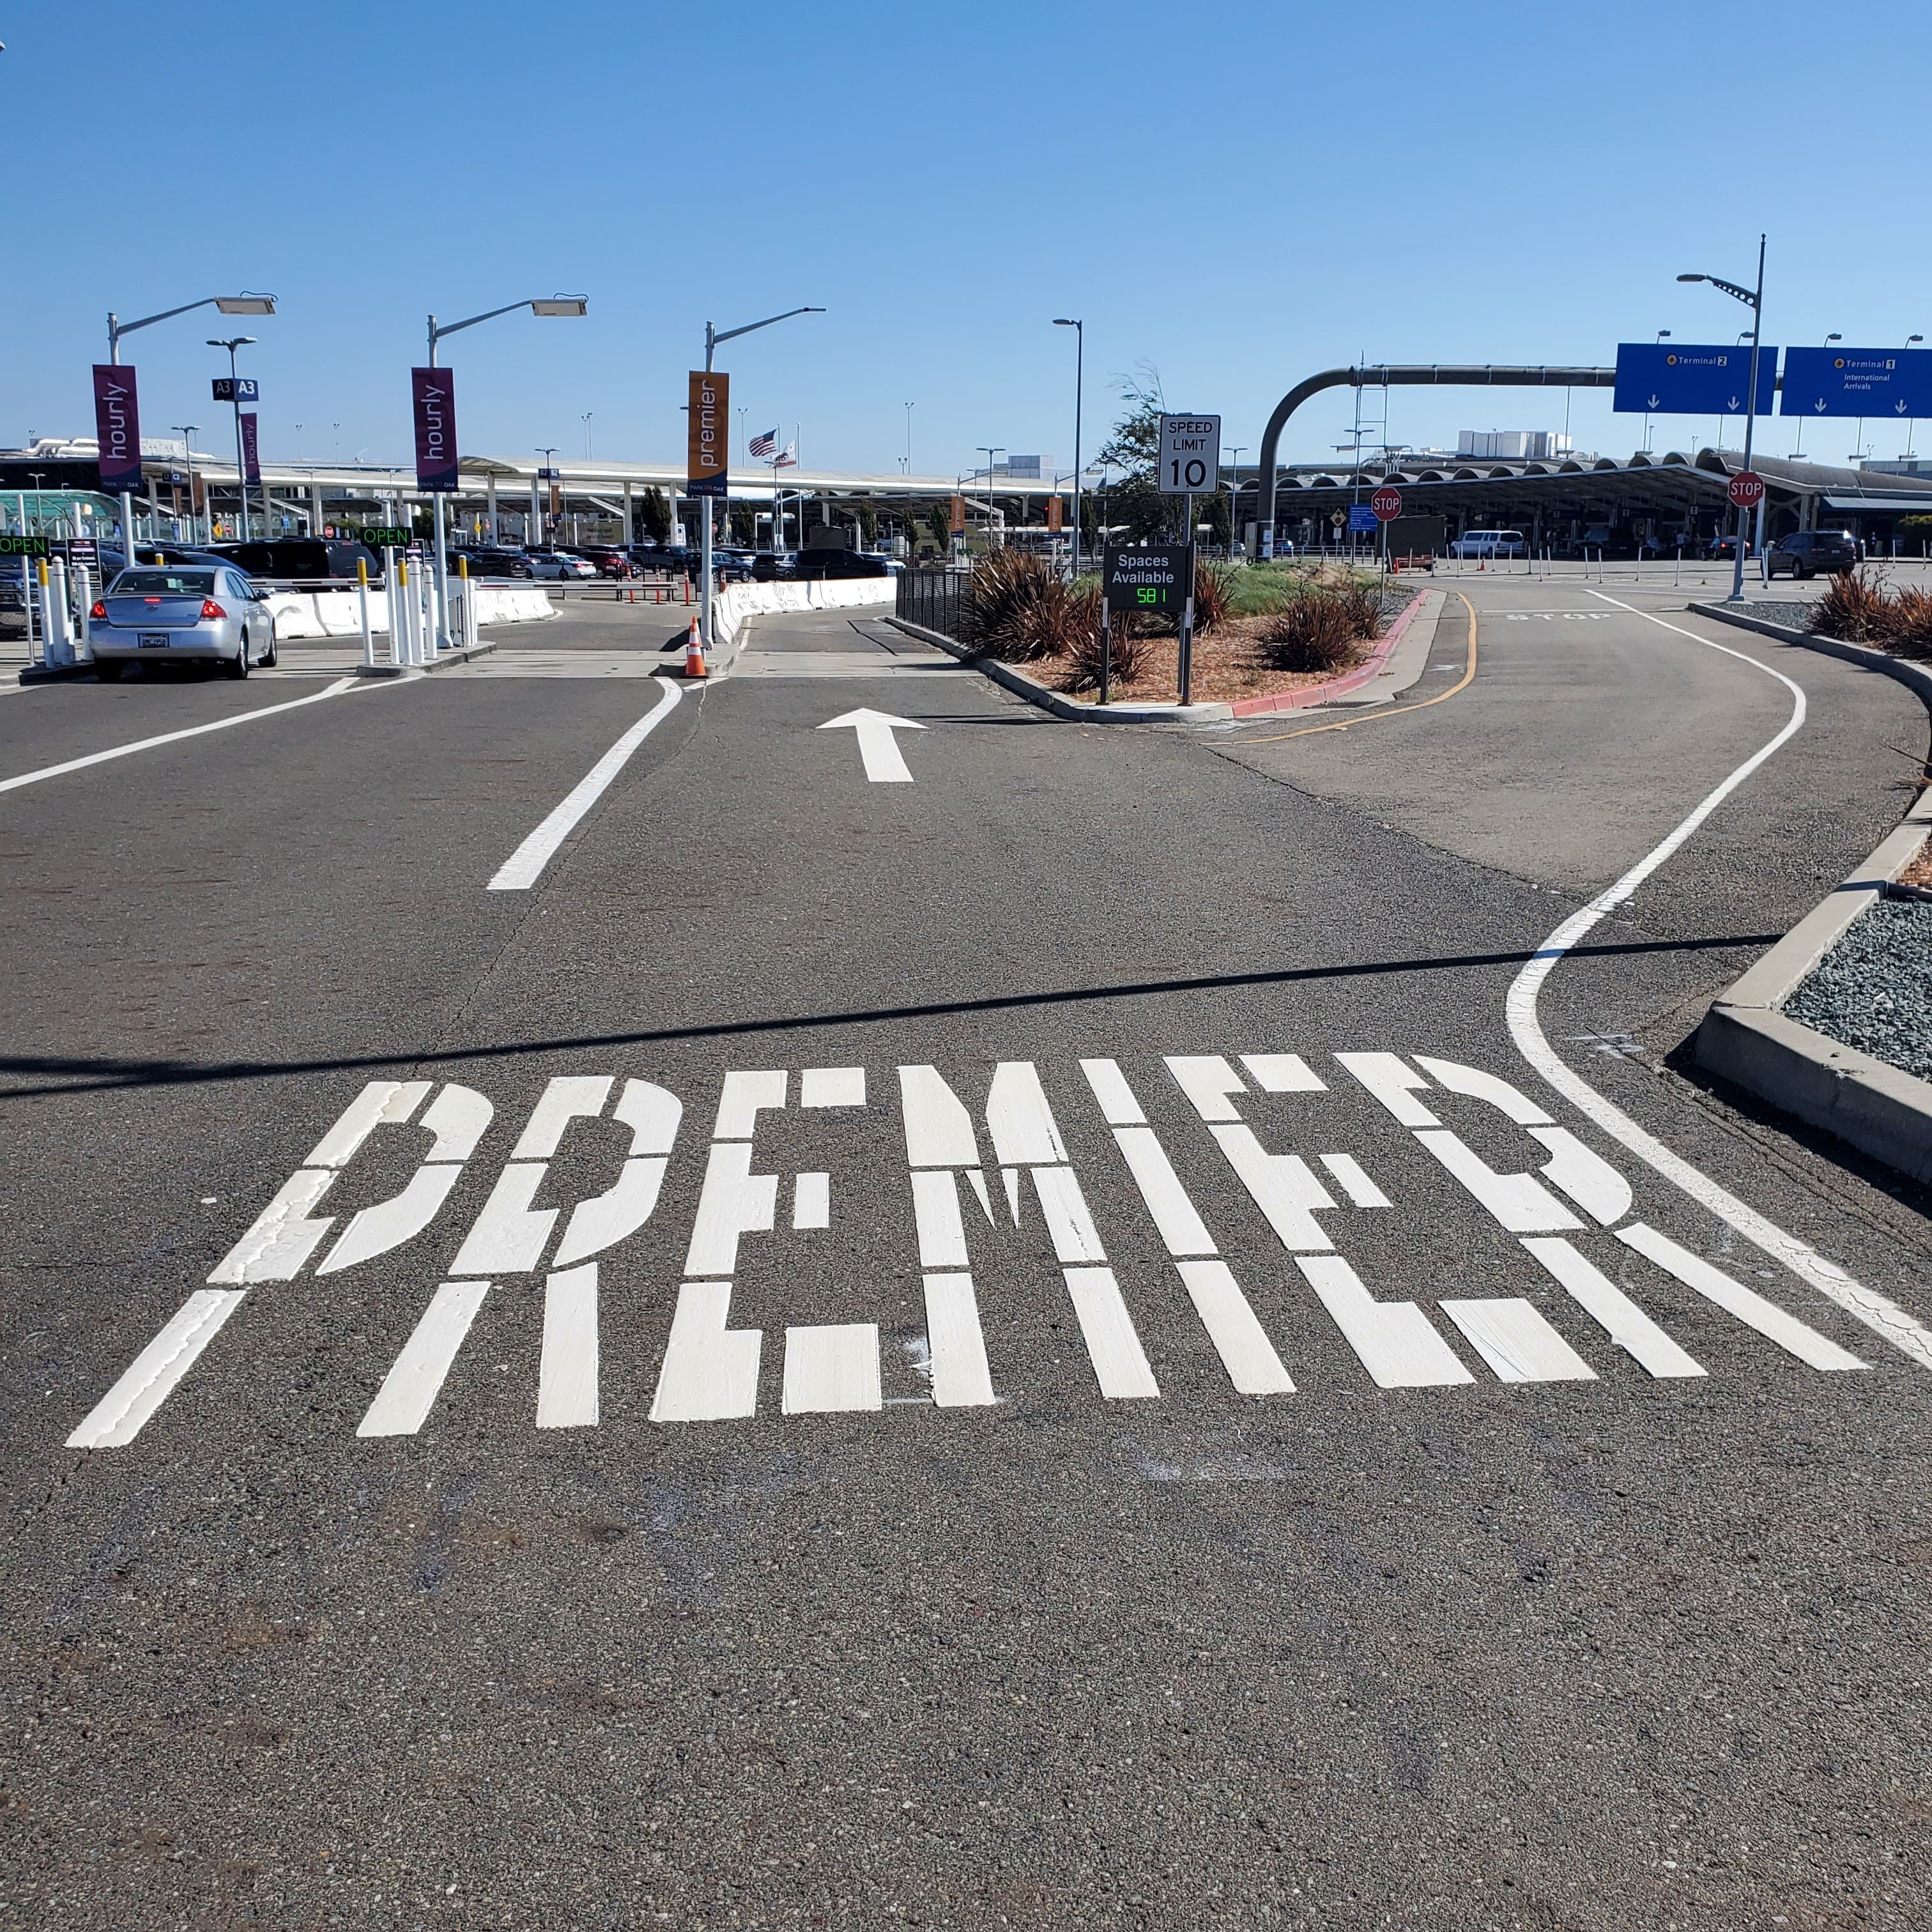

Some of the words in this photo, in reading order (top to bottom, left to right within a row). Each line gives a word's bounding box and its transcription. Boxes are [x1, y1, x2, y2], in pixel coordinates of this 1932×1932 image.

[1678, 356, 1716, 365] Terminal
[1717, 356, 1727, 366] 2
[1846, 360, 1884, 369] Terminal
[1886, 360, 1896, 369] 1
[1844, 374, 1890, 382] International
[216, 381, 230, 394] A3
[238, 381, 254, 394] A3
[102, 383, 128, 459] hourly
[420, 385, 445, 459] hourly
[696, 379, 719, 467] premier
[1169, 422, 1213, 433] SPEED
[245, 424, 256, 464] hourly
[1173, 439, 1206, 450] LIMIT
[1171, 459, 1206, 487] 10
[1730, 482, 1761, 496] STOP
[1374, 498, 1400, 510] STOP
[364, 528, 408, 543] OPEN
[0, 538, 45, 553] OPEN
[1118, 554, 1169, 569] Spaces
[1112, 572, 1174, 583] Available
[1137, 588, 1165, 603] 581
[65, 1050, 1871, 1448] PREMIER
